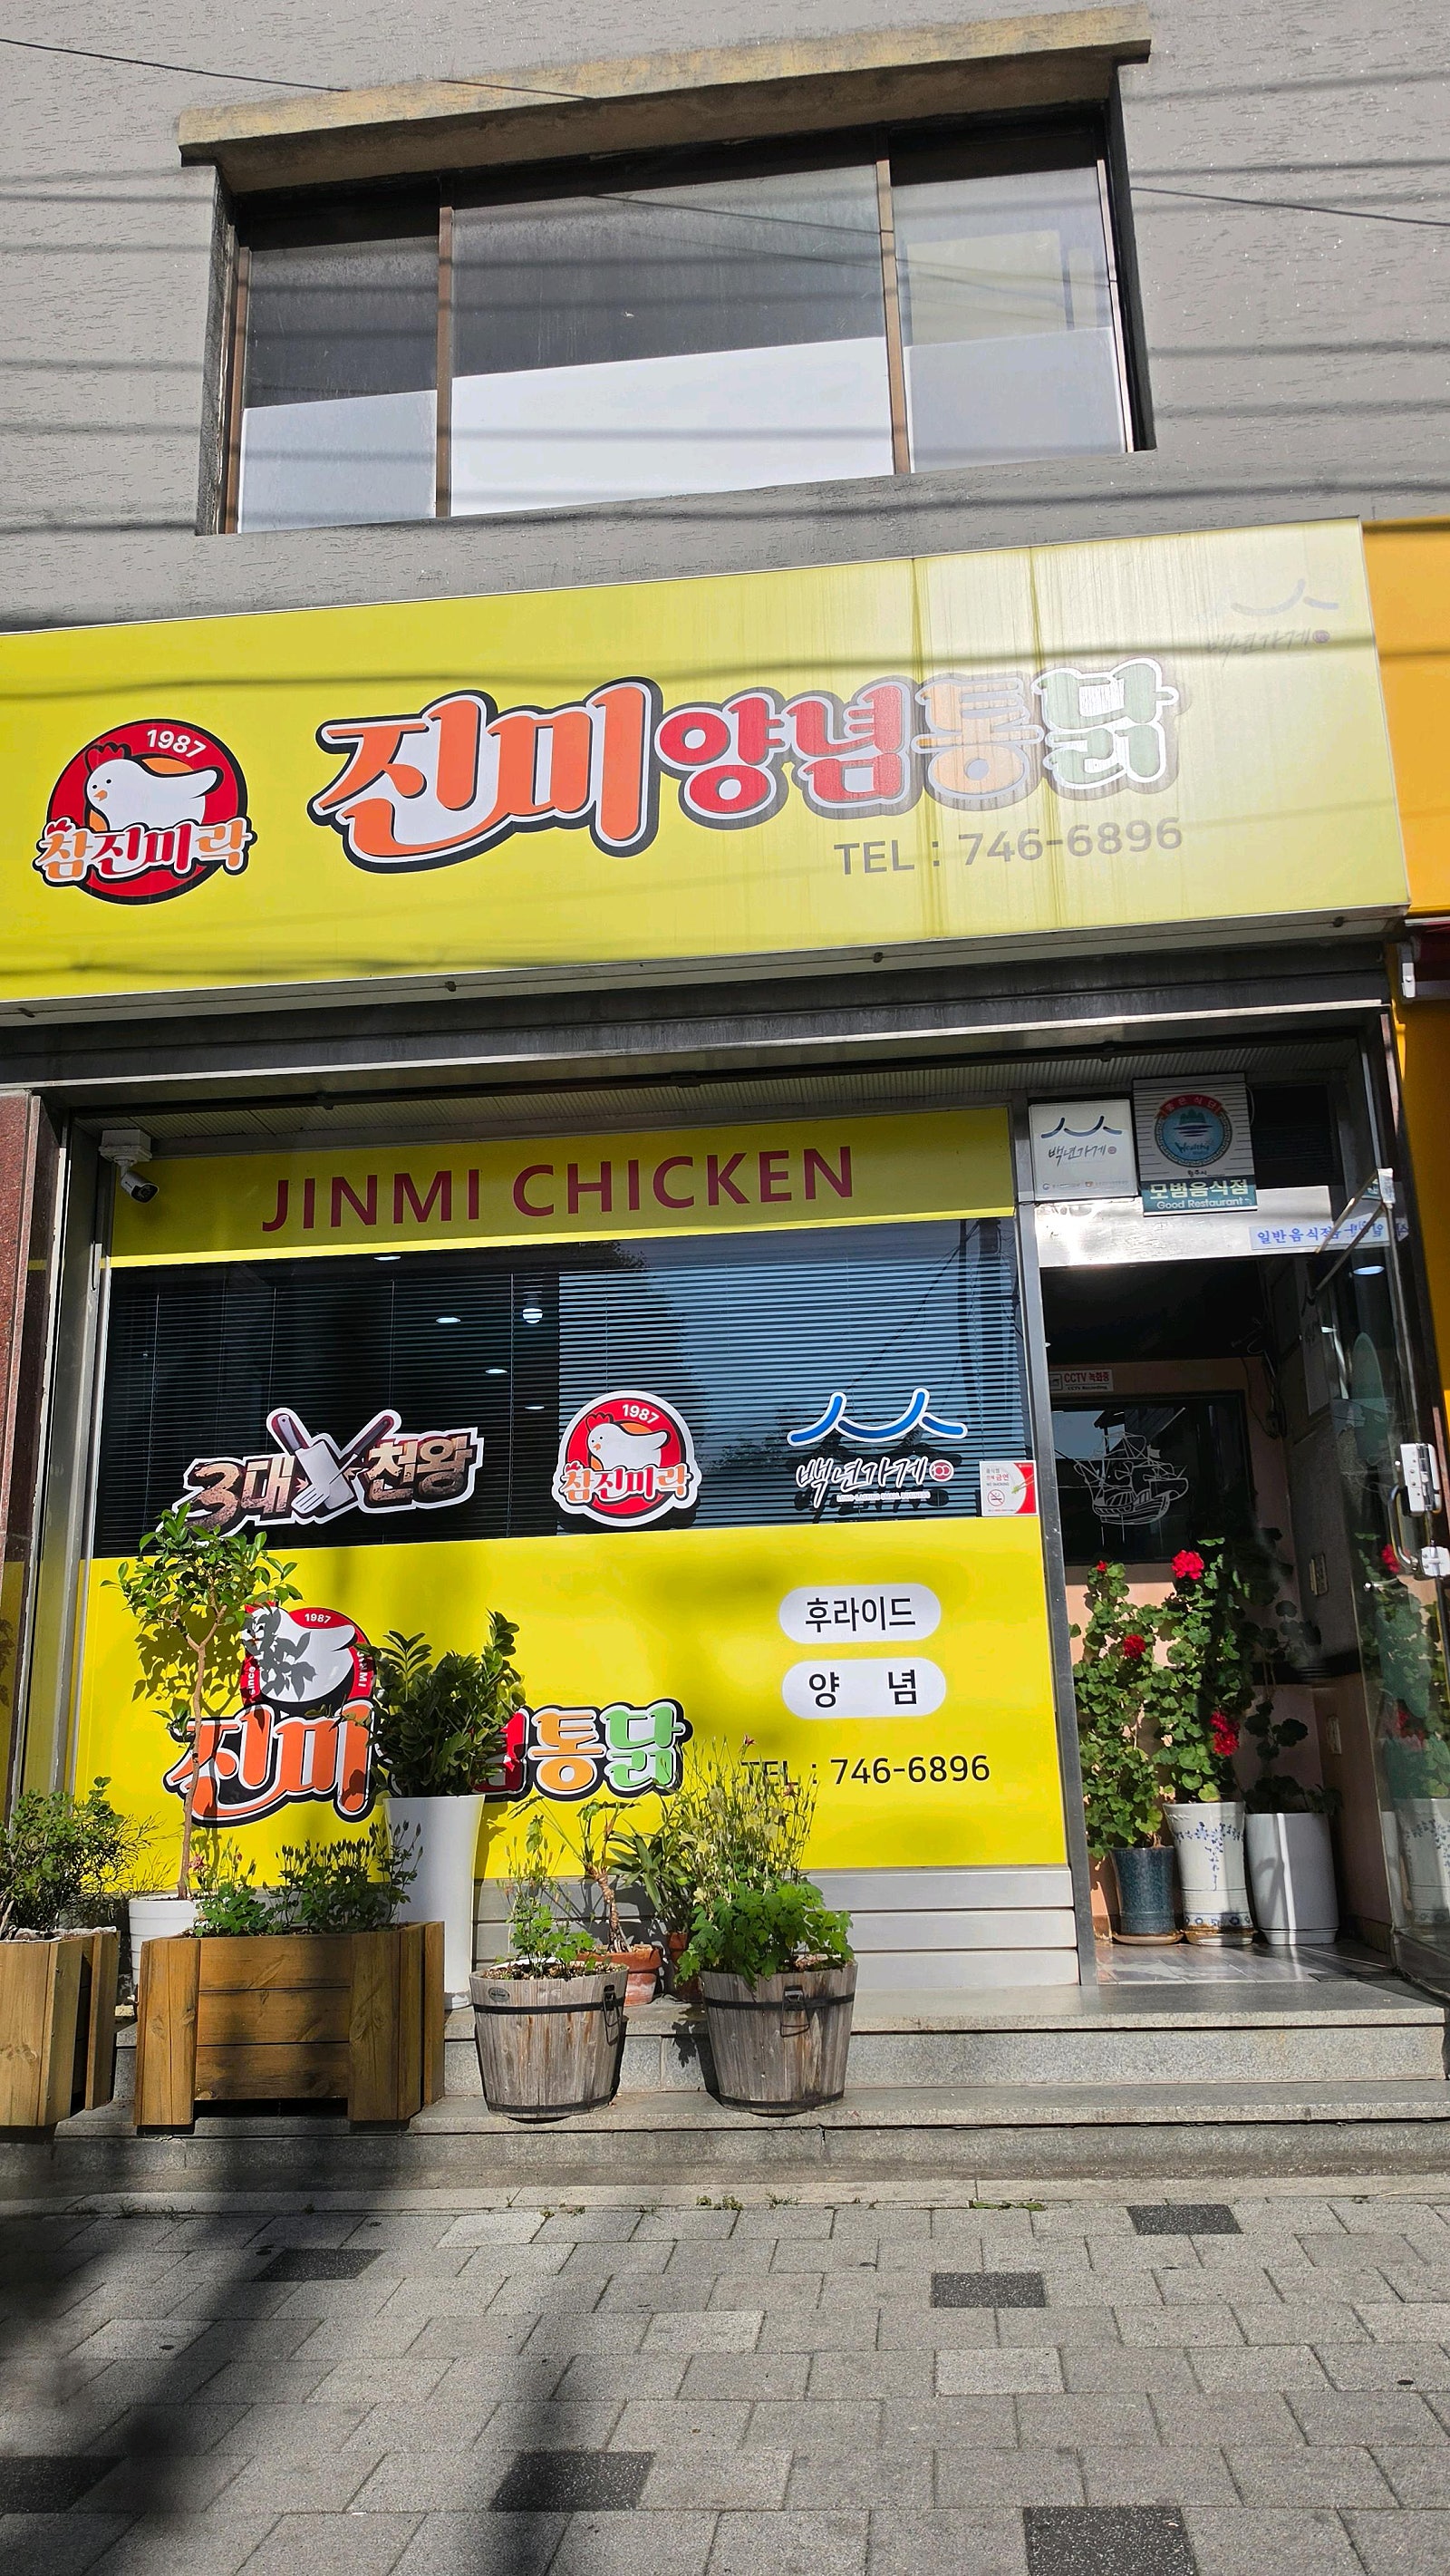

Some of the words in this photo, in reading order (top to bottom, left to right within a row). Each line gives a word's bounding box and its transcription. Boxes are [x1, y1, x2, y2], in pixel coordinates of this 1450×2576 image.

[146, 729, 208, 759] 1987
[38, 818, 253, 880] 참진미락
[834, 839, 914, 876] TEL
[958, 817, 1184, 866] 746-6896
[1048, 1144, 1107, 1167] 백년가게
[262, 1168, 480, 1232] JINMI
[512, 1146, 853, 1217] CHICKEN
[1149, 1178, 1249, 1200] 모범음식점
[1156, 1200, 1185, 1210] Good
[1187, 1196, 1243, 1208] Restaurant
[1064, 1372, 1087, 1383] CCTV
[622, 1404, 660, 1424] 1987
[366, 1436, 473, 1502] 천왕
[561, 1463, 691, 1501] 참진미락
[796, 1457, 928, 1508] 백년가게
[304, 1613, 332, 1624] 1987
[805, 1595, 916, 1632] 후라이드
[741, 1760, 798, 1787] TEL
[830, 1755, 991, 1785] 746-6896
